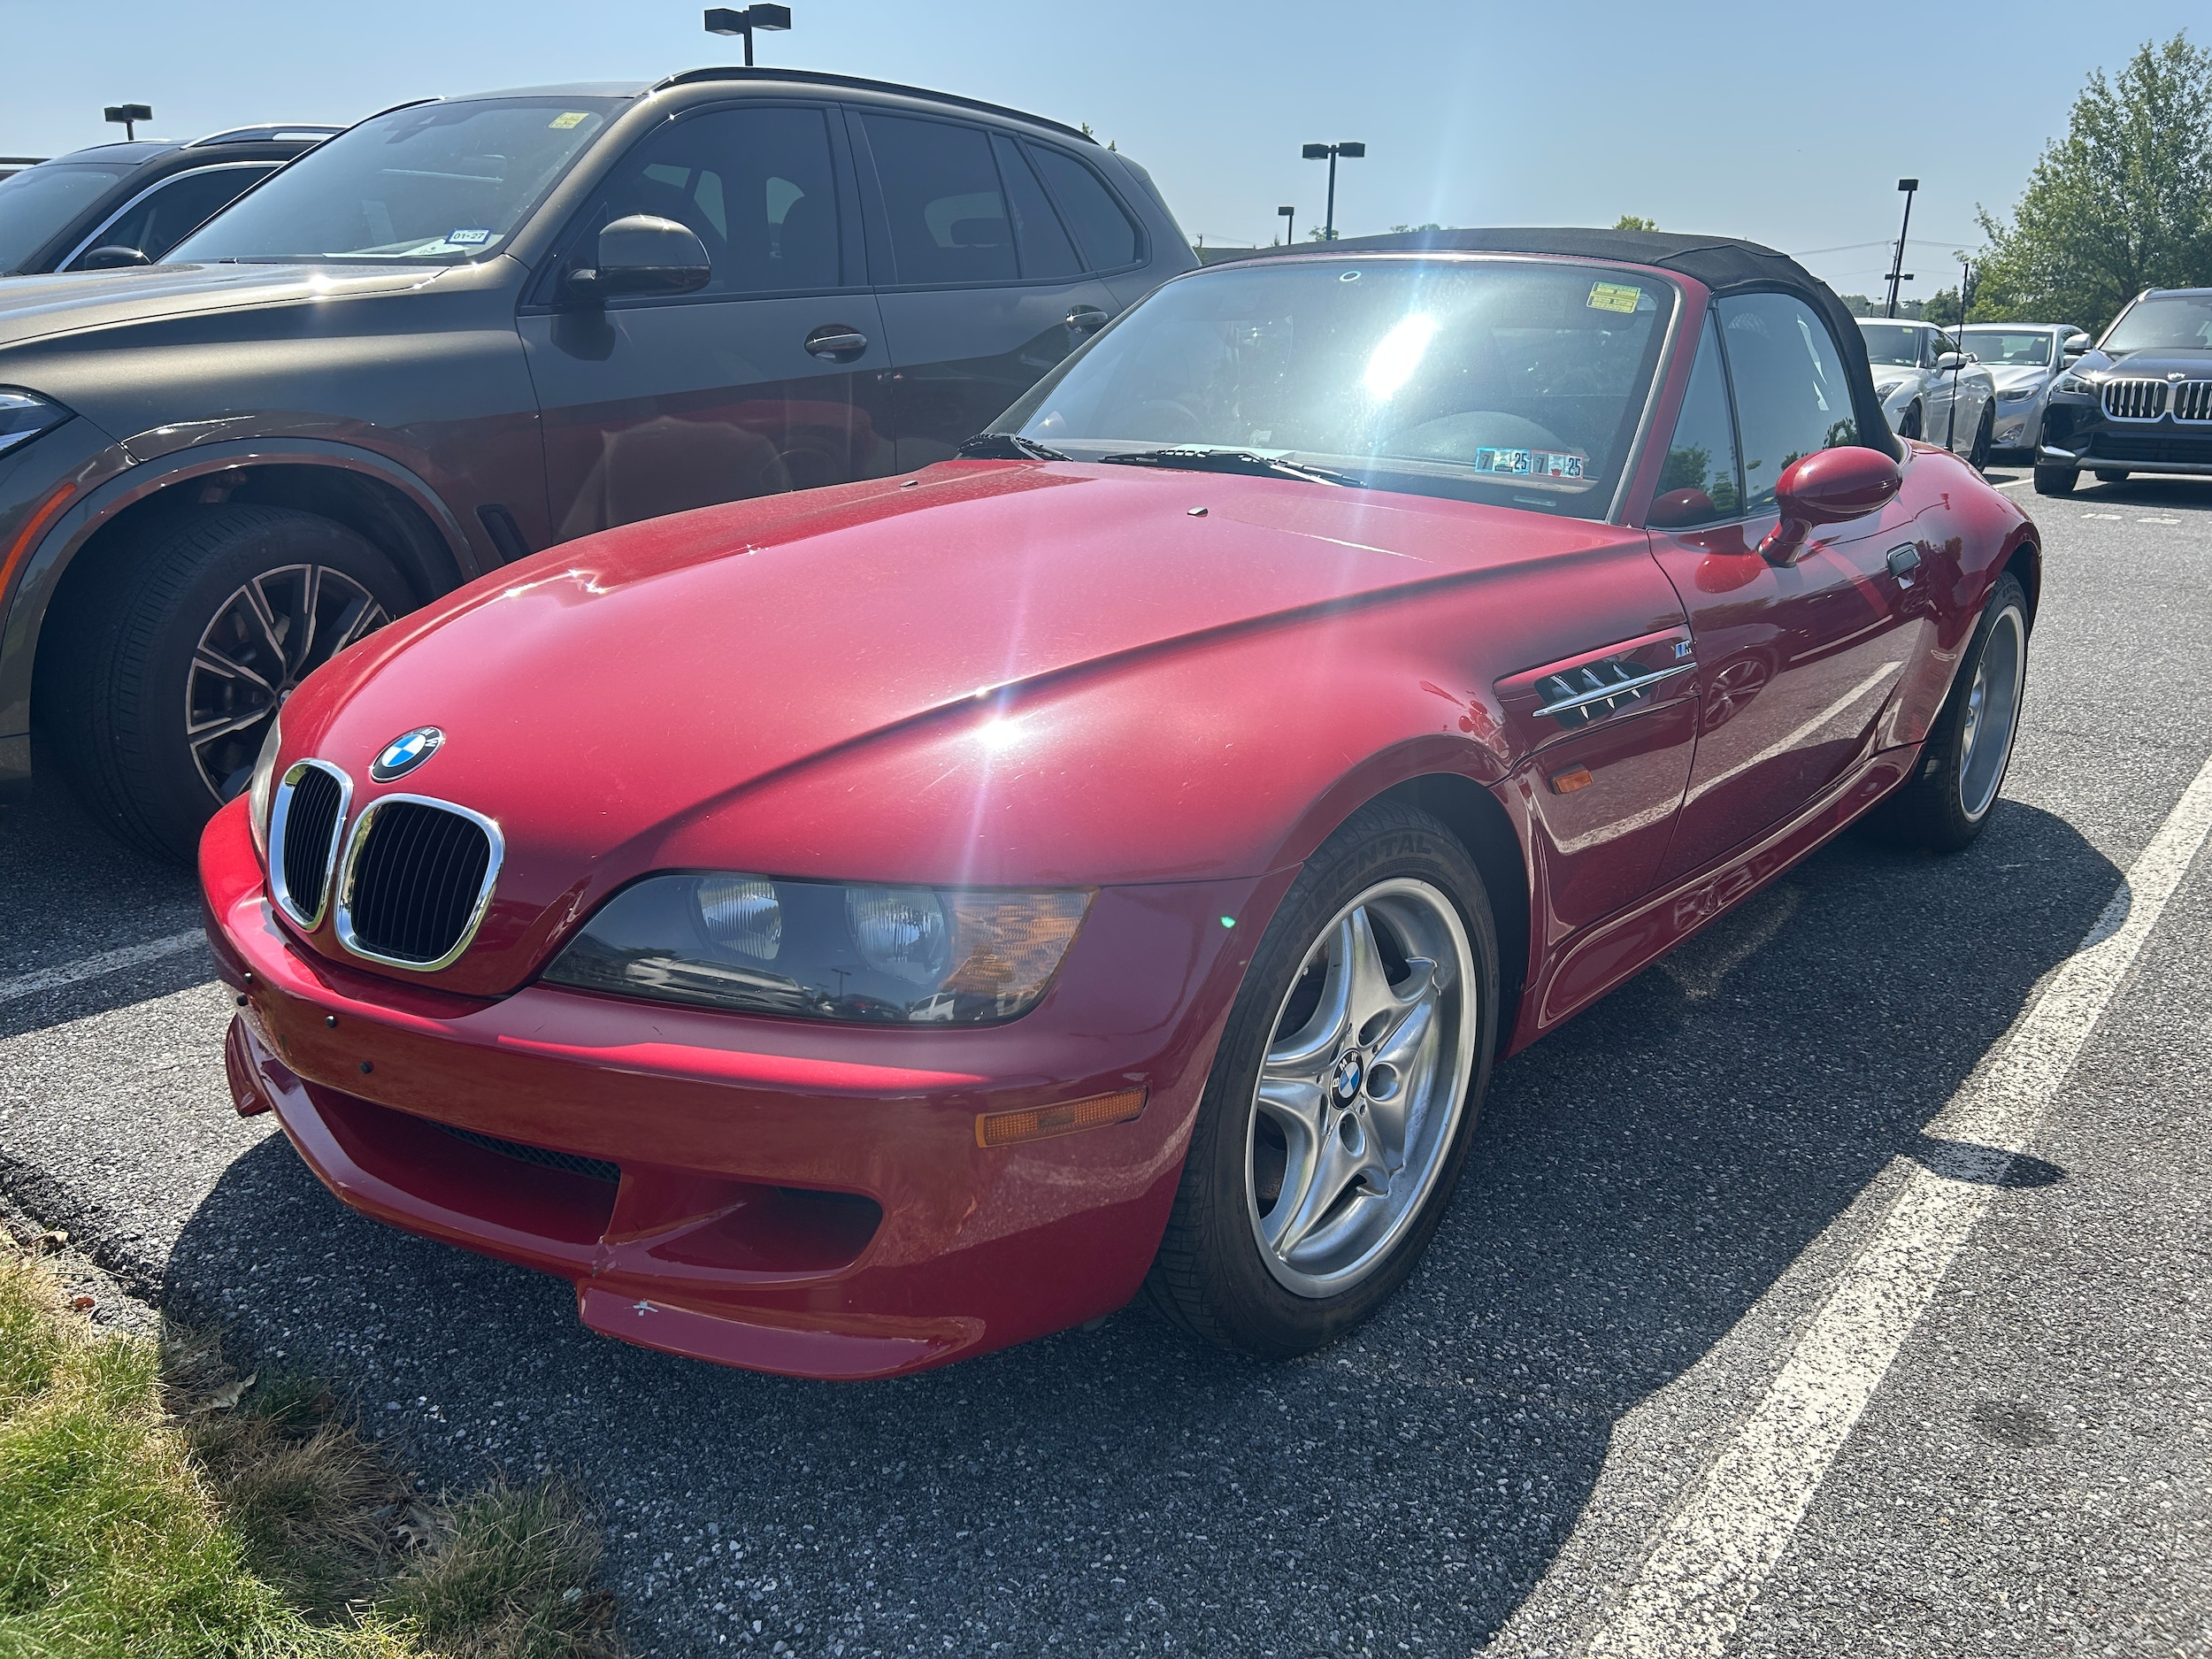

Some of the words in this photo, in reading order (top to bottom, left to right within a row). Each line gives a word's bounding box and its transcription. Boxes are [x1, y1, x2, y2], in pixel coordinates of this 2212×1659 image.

[1481, 454, 1491, 469] 7
[1514, 452, 1527, 470] 25
[1536, 457, 1546, 473] 7
[1569, 457, 1581, 476] 25
[1333, 1052, 1358, 1087] BMW
